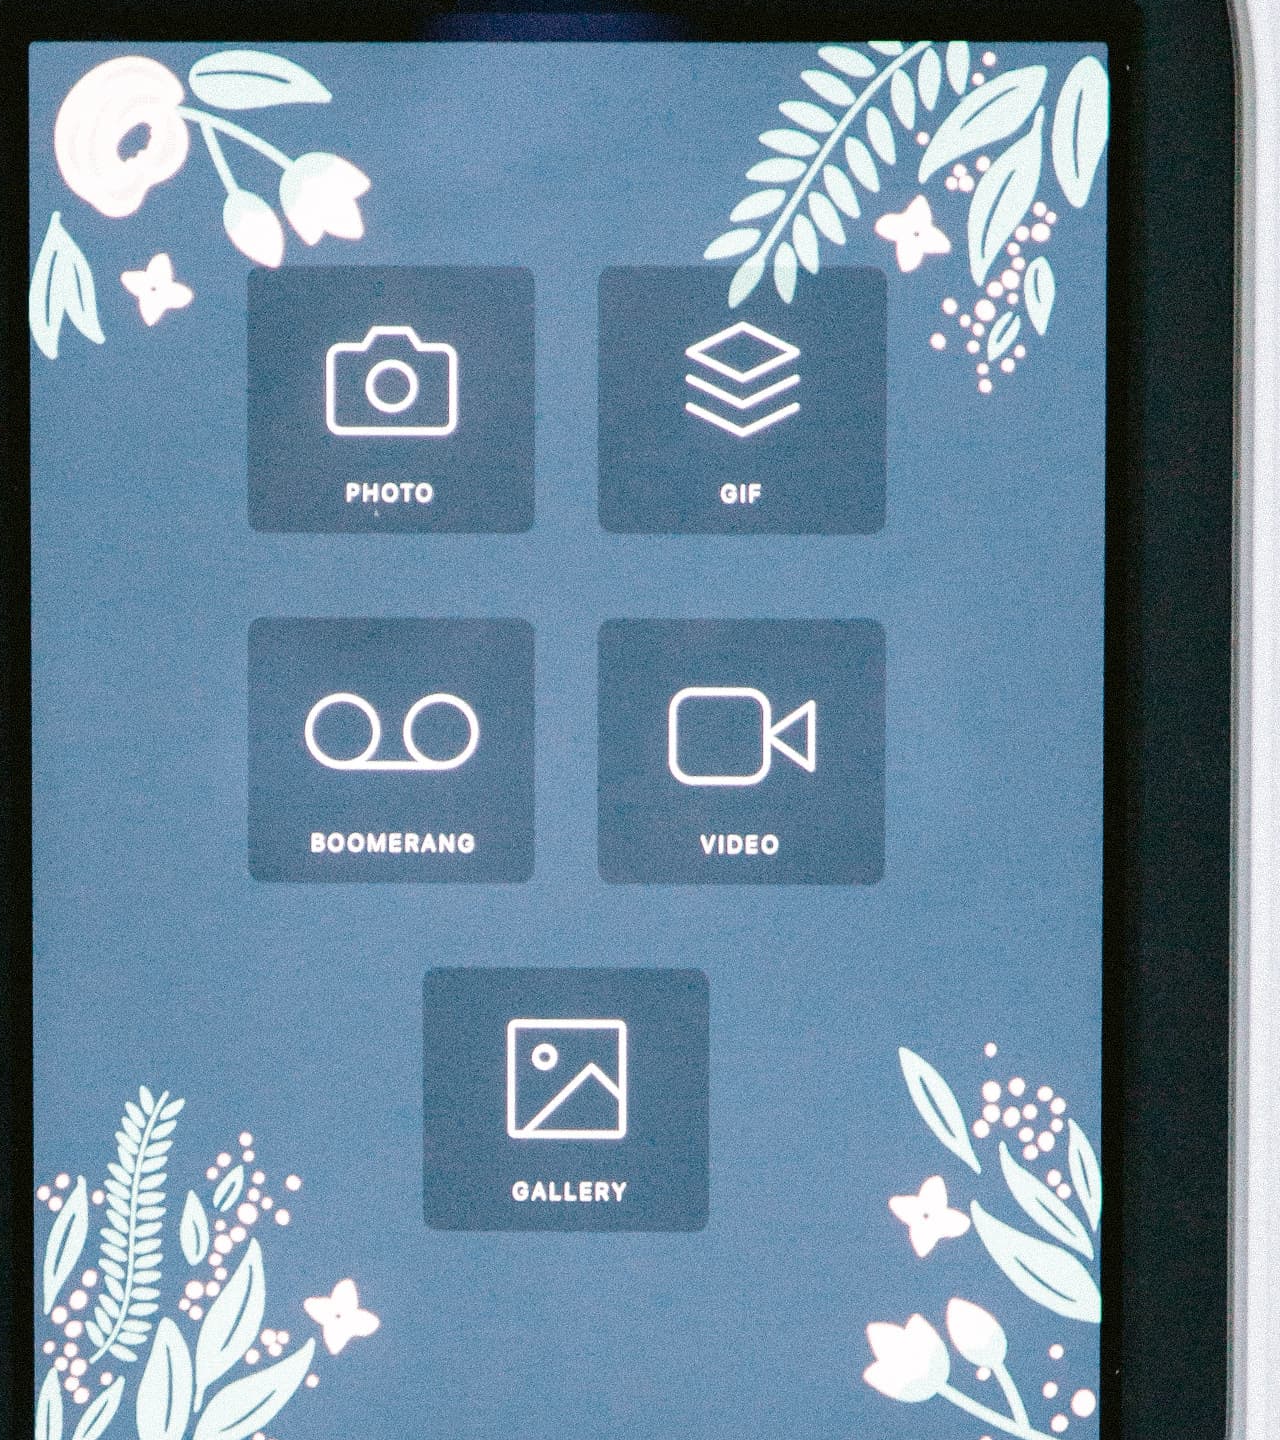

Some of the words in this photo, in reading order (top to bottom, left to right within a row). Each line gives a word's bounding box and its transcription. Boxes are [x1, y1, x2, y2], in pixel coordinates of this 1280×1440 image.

[345, 481, 435, 504] PHOTO
[719, 482, 763, 505] GIF
[310, 831, 476, 855] BOOMERANG
[699, 833, 780, 856] VIDEO
[511, 1180, 628, 1203] GALLERY
